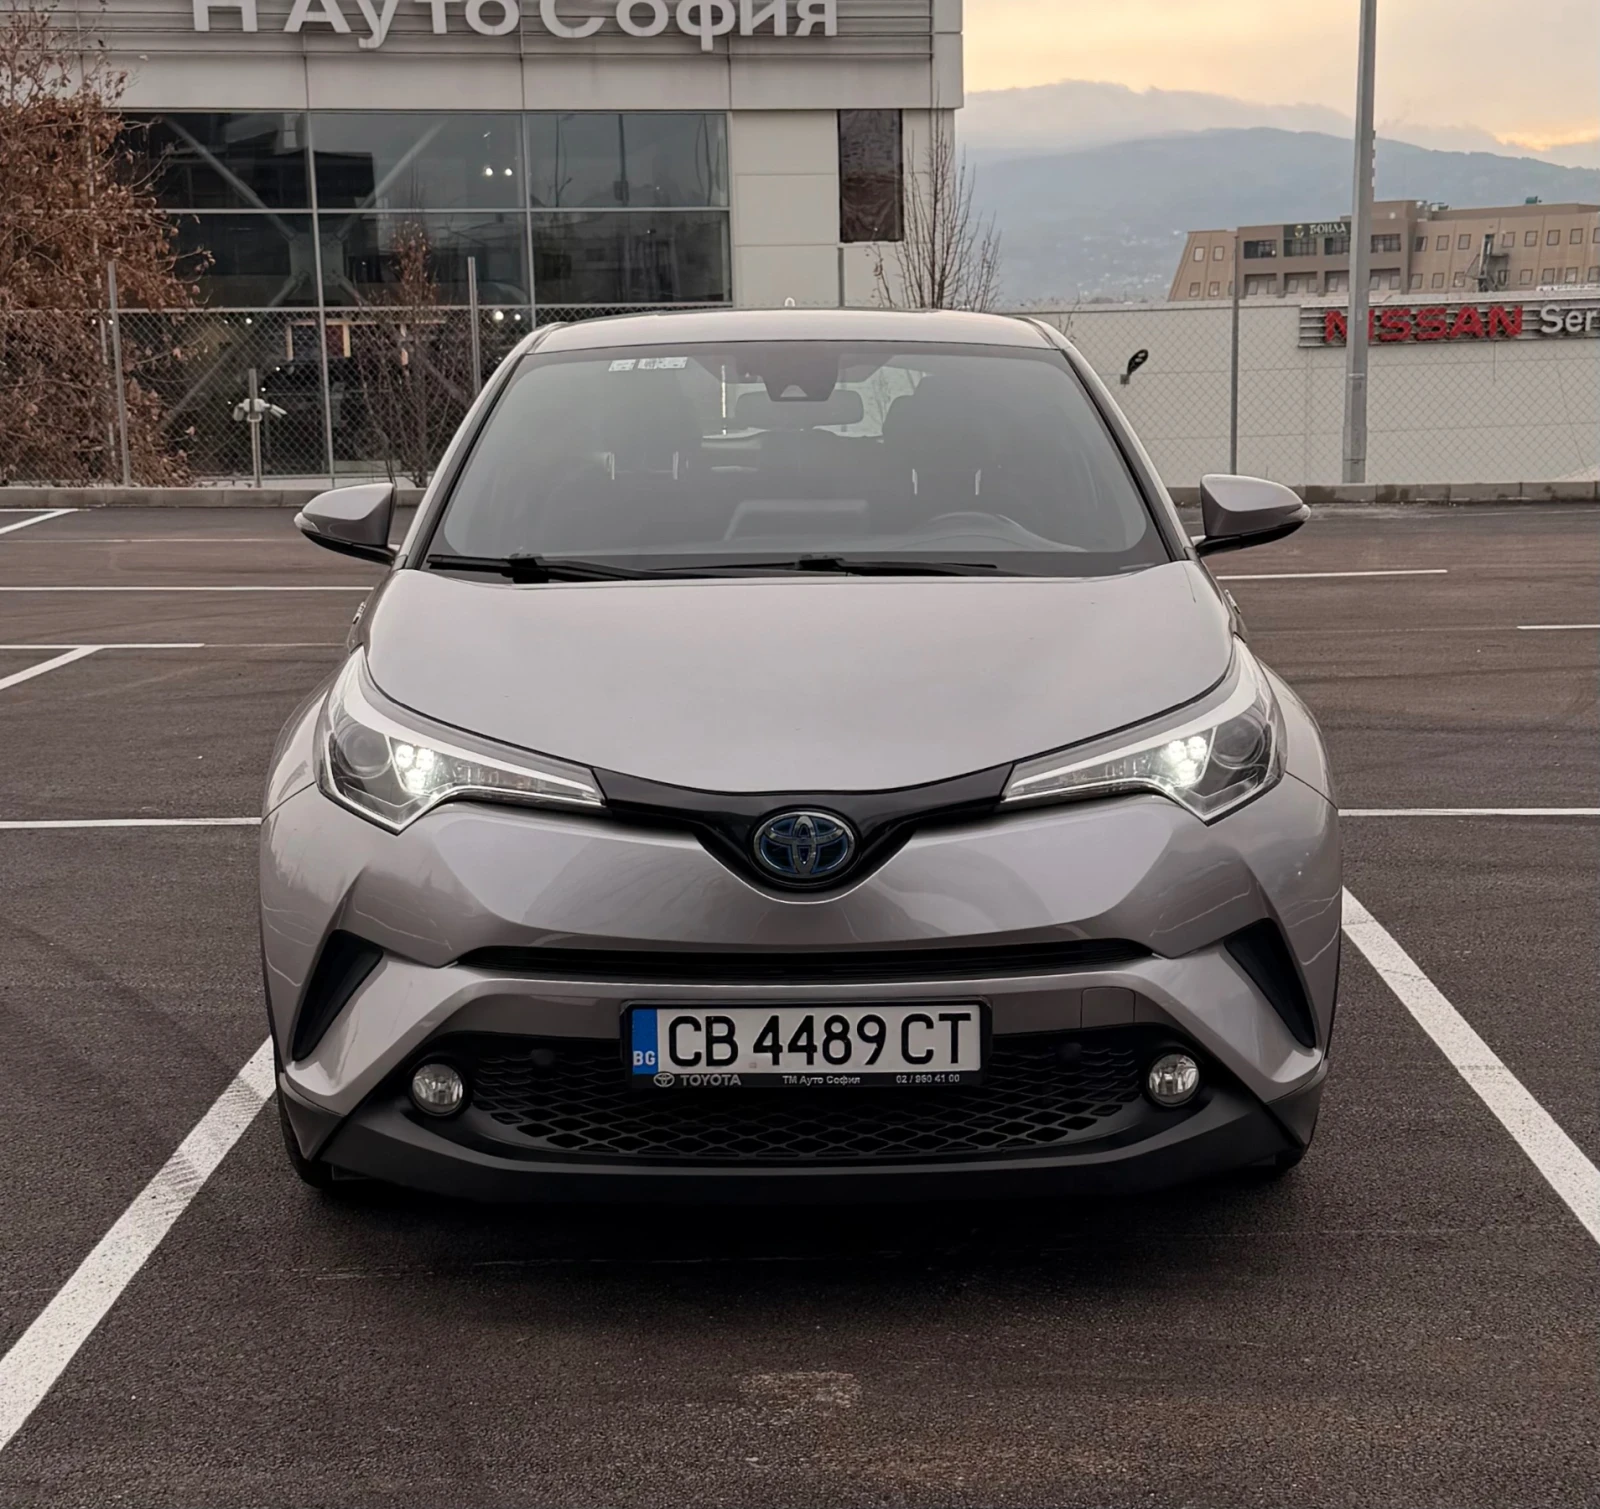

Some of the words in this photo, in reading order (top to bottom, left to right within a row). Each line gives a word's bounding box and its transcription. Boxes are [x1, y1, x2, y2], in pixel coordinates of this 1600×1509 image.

[283, 0, 520, 49] Ауто
[539, 0, 838, 52] София
[1324, 304, 1523, 343] NISSAN
[1540, 304, 1598, 334] Ser
[668, 1014, 739, 1067] CB
[753, 1014, 887, 1066] 4489
[900, 1012, 972, 1065] CT
[633, 1050, 656, 1067] BG
[680, 1074, 741, 1087] TOYOTA
[799, 1075, 824, 1086] Ауто
[896, 1075, 907, 1084] 02
[934, 1074, 945, 1083] 41
